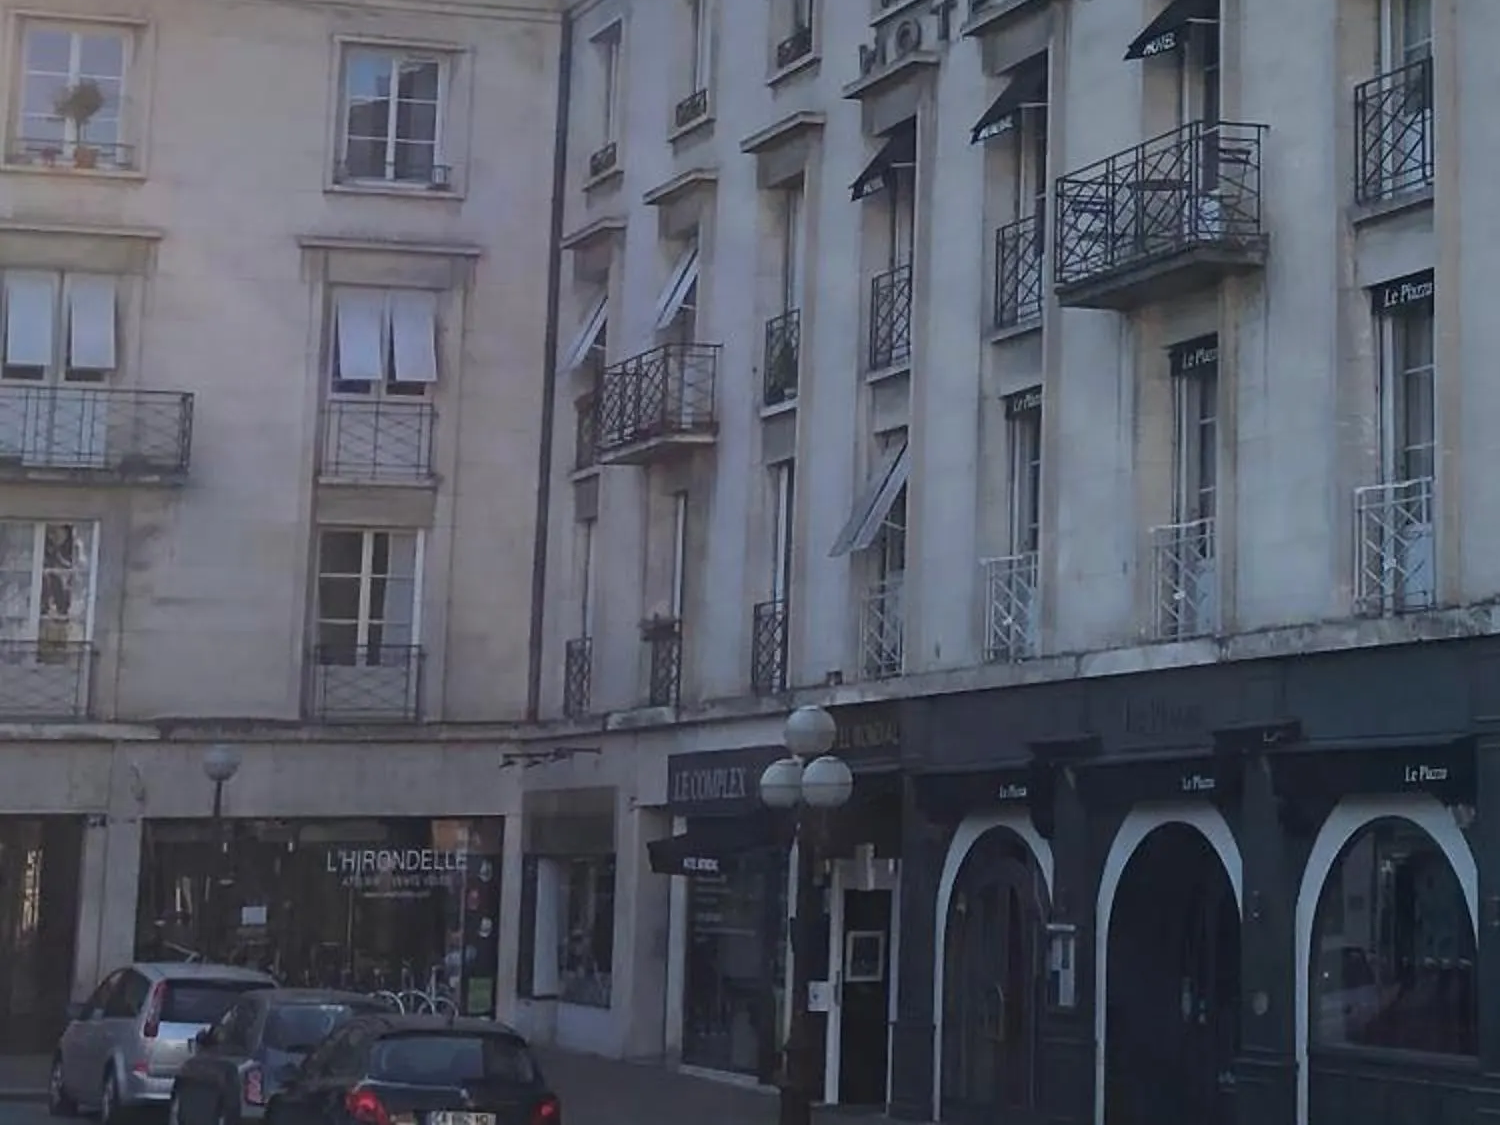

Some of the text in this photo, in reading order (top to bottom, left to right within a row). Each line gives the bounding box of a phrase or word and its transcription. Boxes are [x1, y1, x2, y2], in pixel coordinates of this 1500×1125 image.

[1383, 287, 1399, 307] Le
[1404, 765, 1418, 782] Le
[326, 850, 468, 873] L'HIRONDELLE
